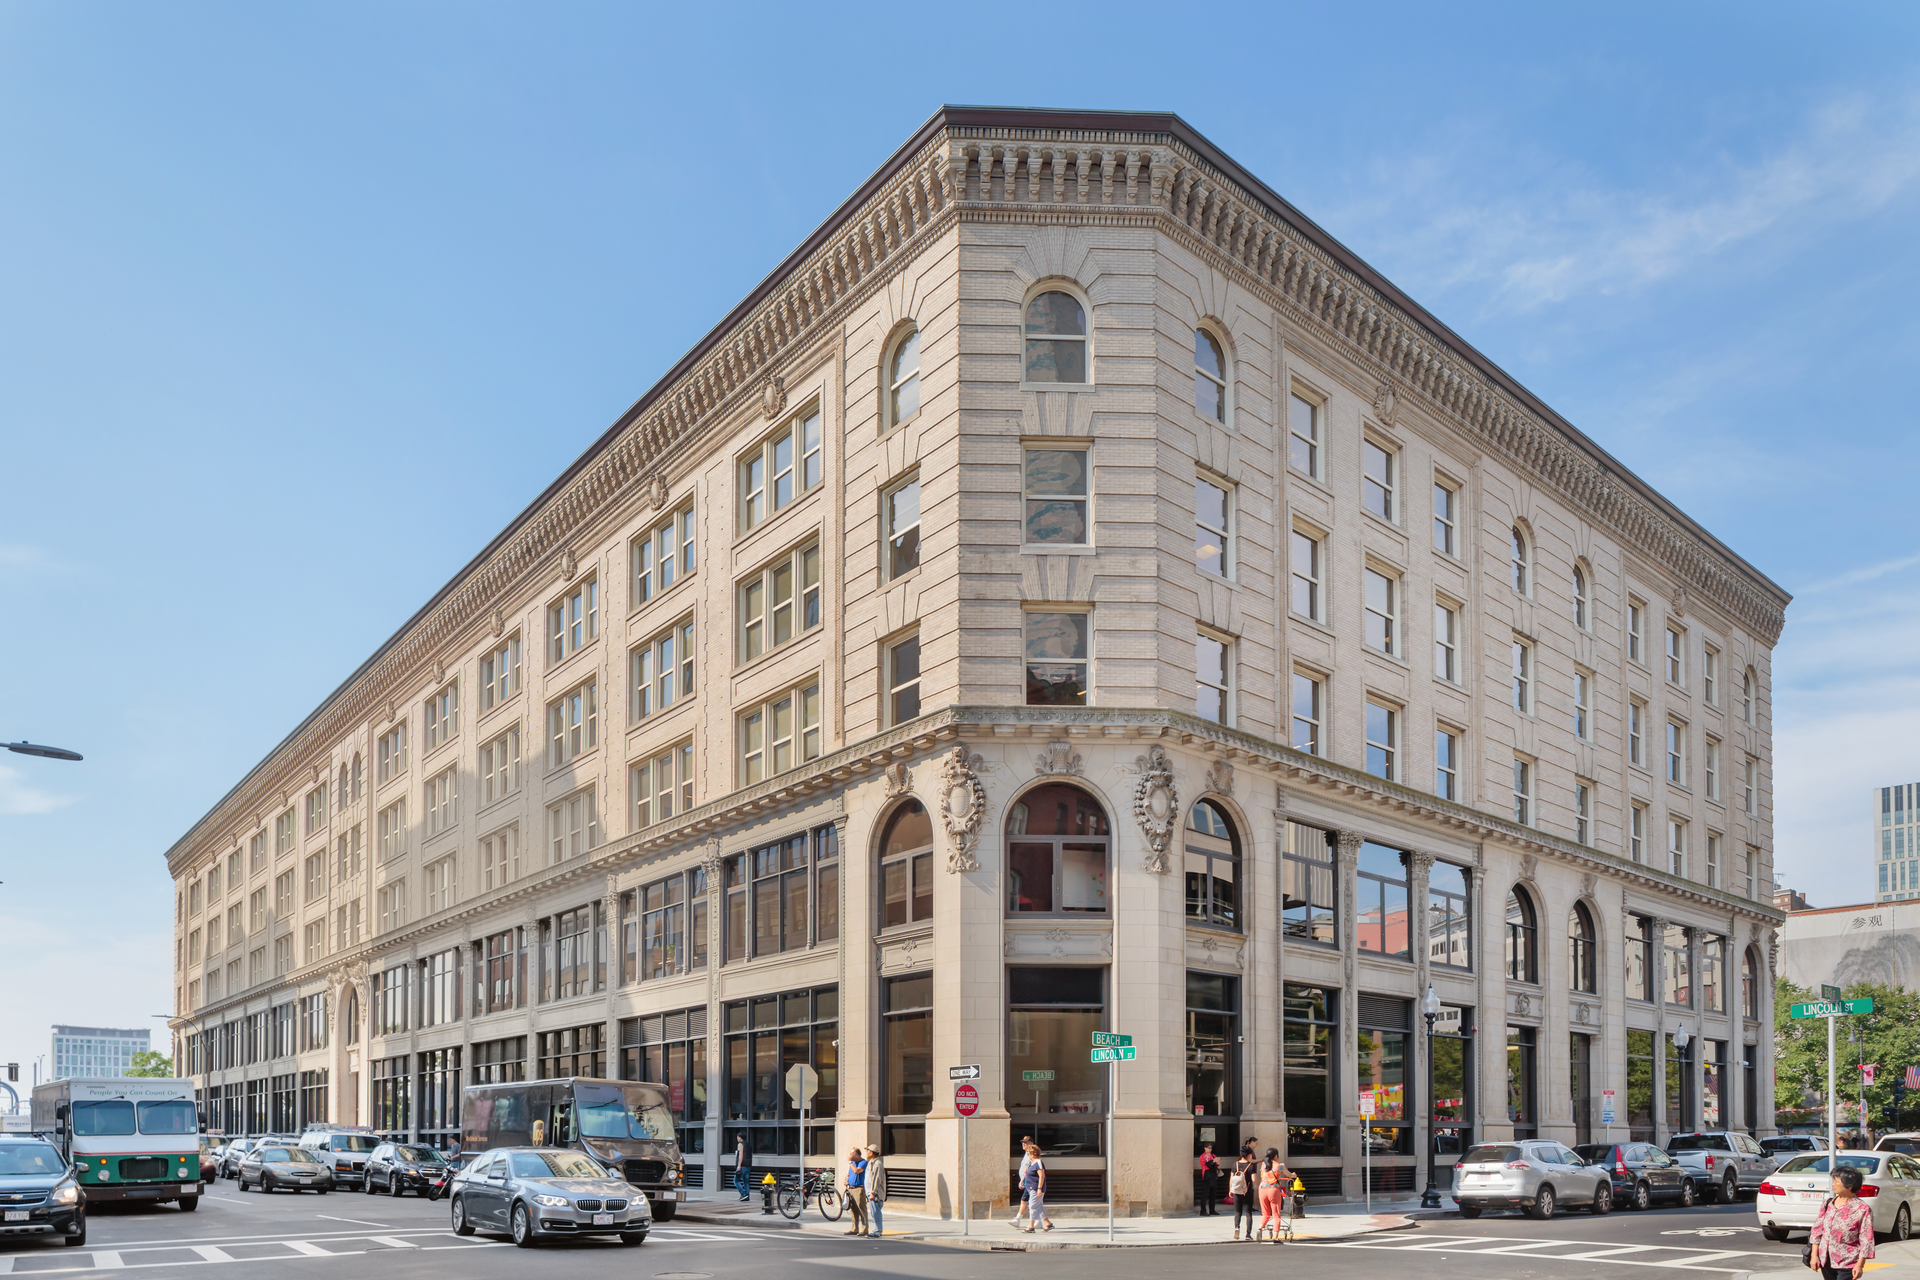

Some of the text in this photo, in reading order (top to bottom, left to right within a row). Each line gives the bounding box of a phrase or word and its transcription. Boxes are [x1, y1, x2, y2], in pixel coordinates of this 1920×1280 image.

[1852, 914, 1883, 929] 参观
[1803, 1001, 1854, 1016] LINCOLN ST
[1096, 1034, 1120, 1045] BEACH
[1094, 1048, 1124, 1061] LINCOLN
